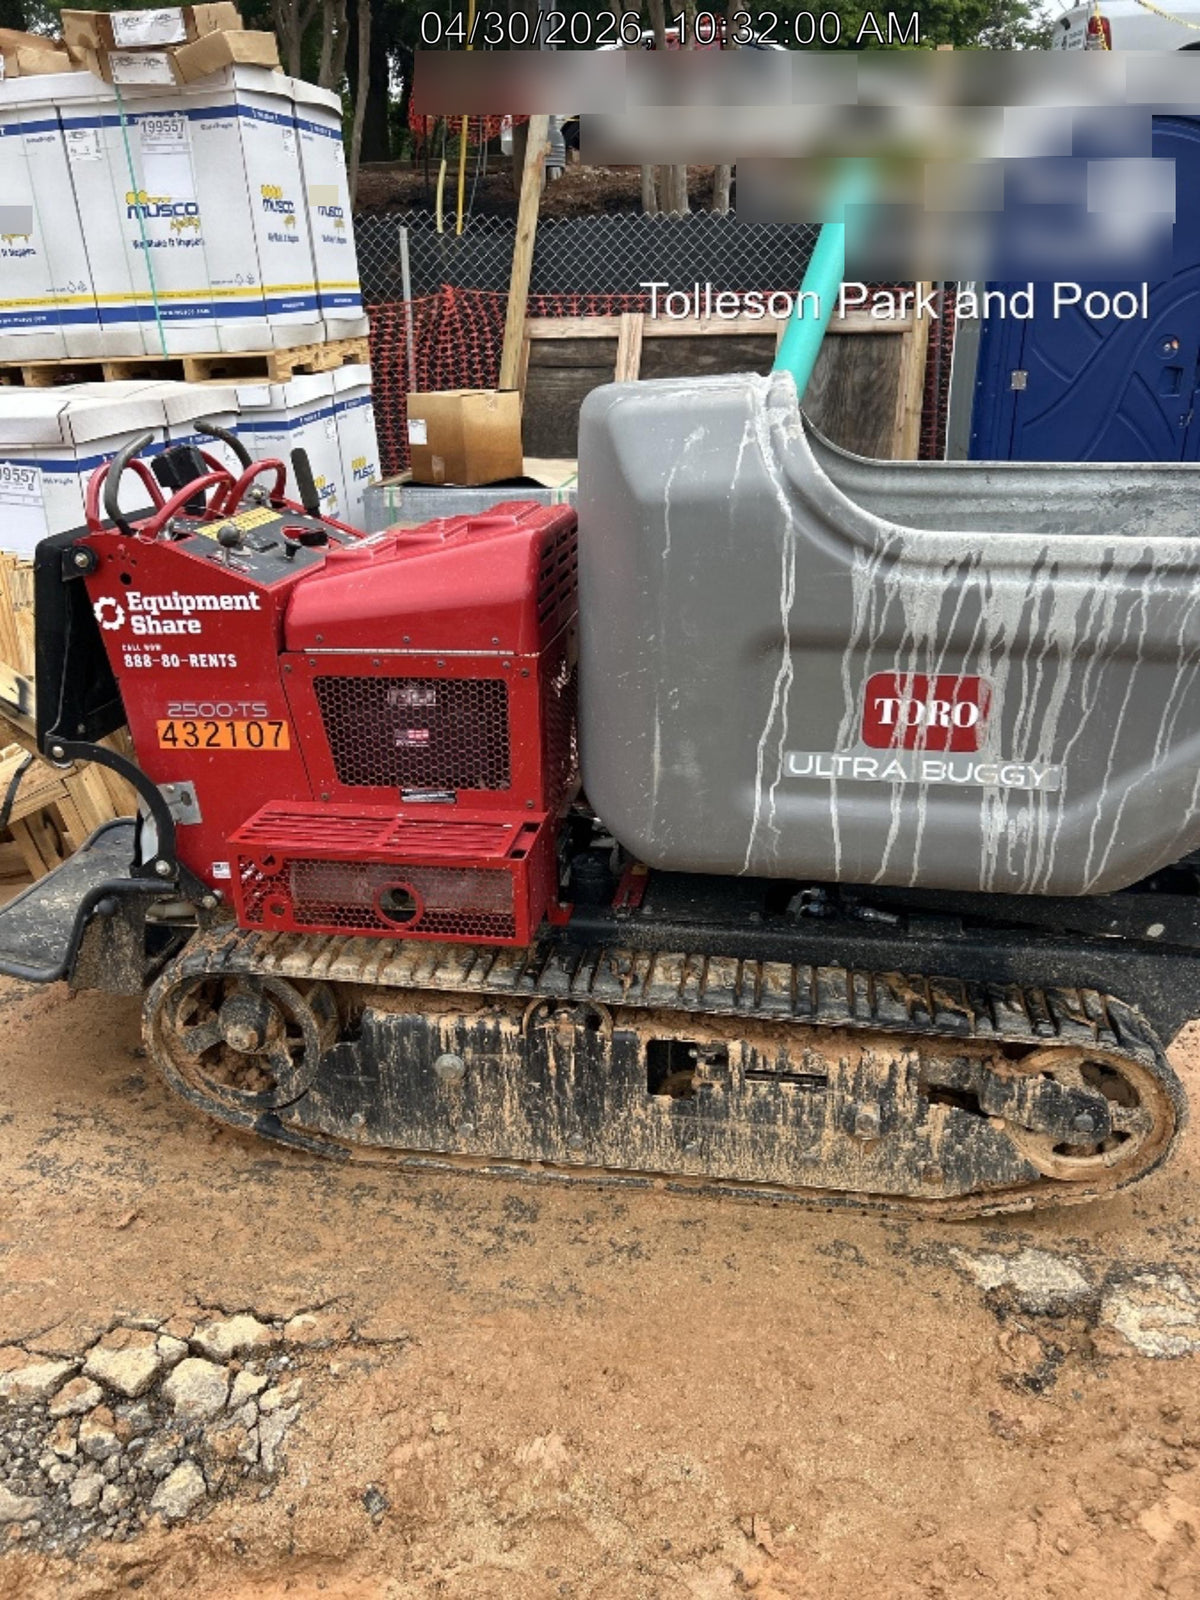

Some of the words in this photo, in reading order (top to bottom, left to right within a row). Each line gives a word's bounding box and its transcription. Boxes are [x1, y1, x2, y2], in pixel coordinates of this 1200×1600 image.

[141, 120, 185, 133] 199557
[0, 467, 37, 483] 9557
[125, 591, 261, 615] Equipment
[130, 615, 201, 635] Share
[123, 653, 237, 668] 888-80-RENTS
[874, 698, 979, 728] TORO
[161, 721, 284, 748] 432107
[788, 754, 907, 780] ULTRA
[921, 760, 1051, 786] BUGGY
